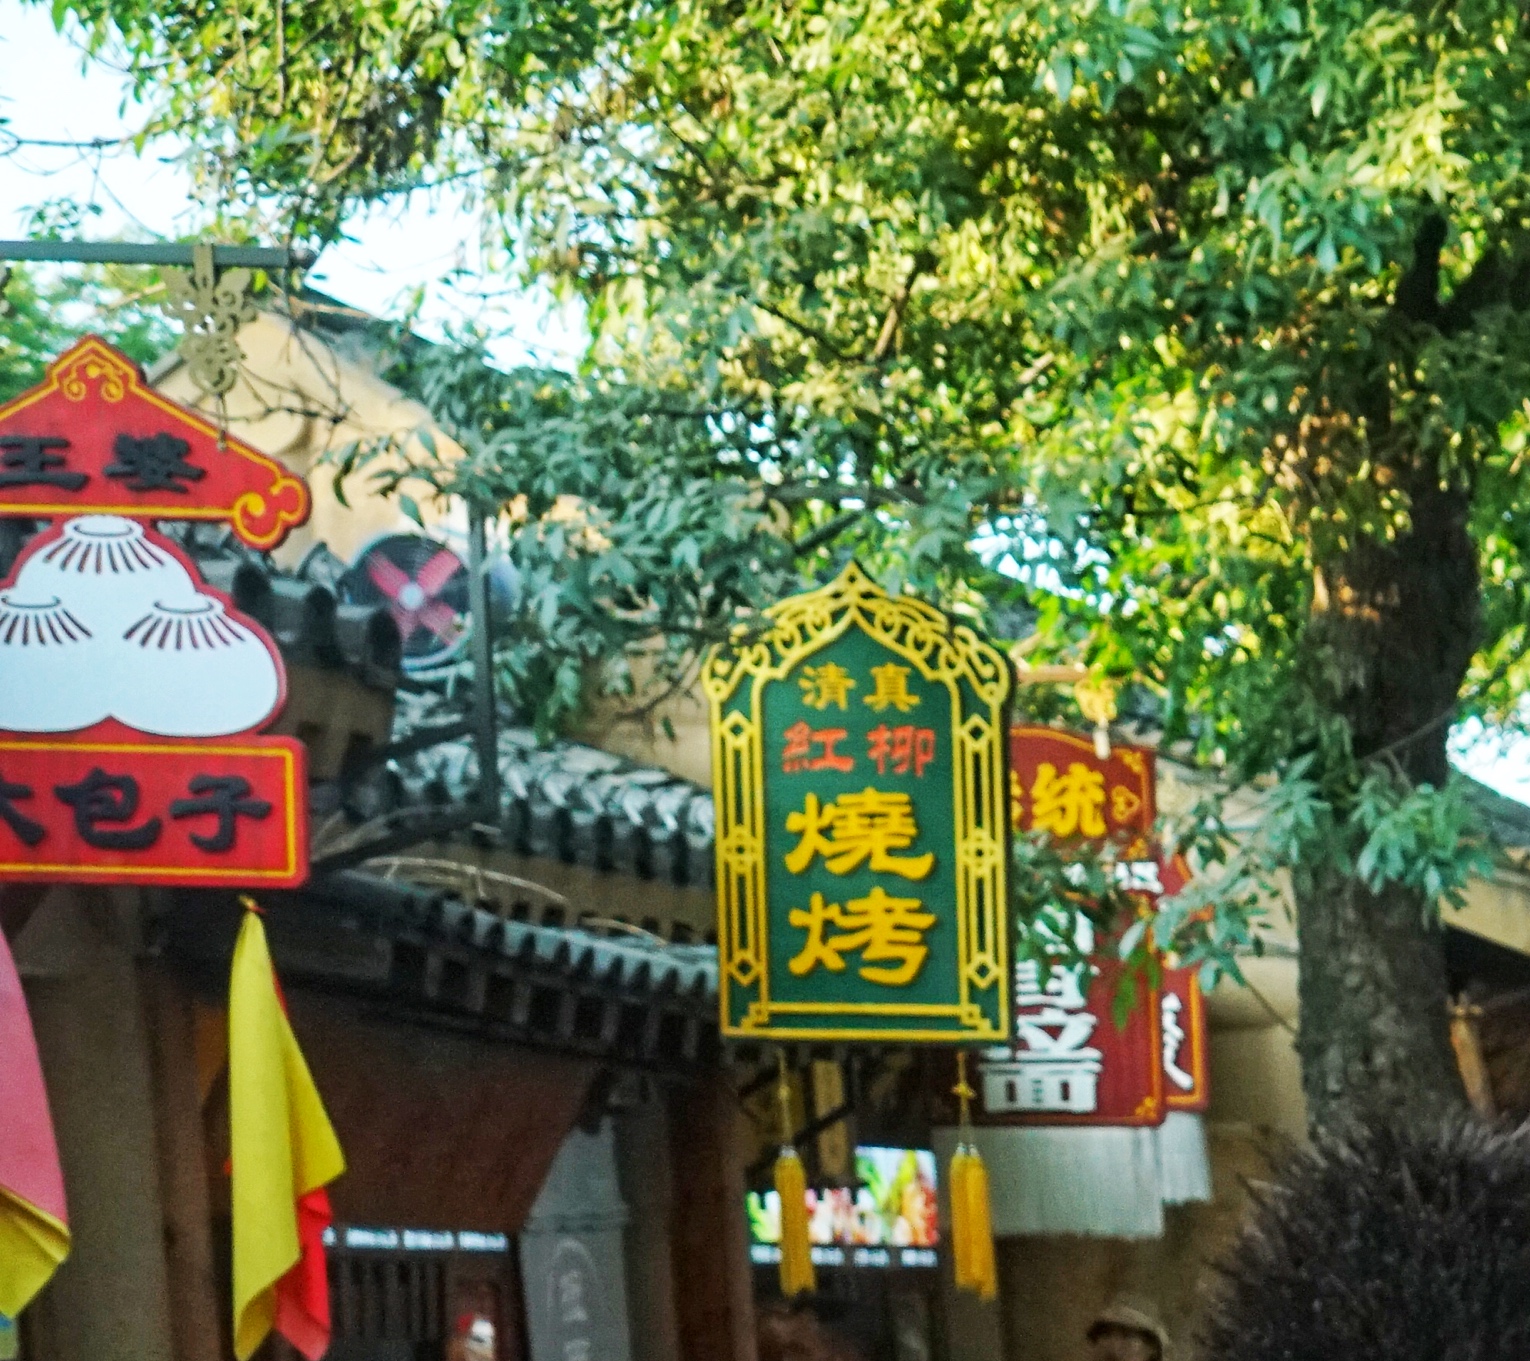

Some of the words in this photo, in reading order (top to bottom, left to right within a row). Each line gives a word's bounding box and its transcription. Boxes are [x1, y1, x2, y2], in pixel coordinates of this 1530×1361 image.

[0, 432, 205, 493] 王婆
[798, 664, 921, 711] 清真
[781, 721, 935, 777] 紅柳
[784, 785, 936, 986] 燒烤
